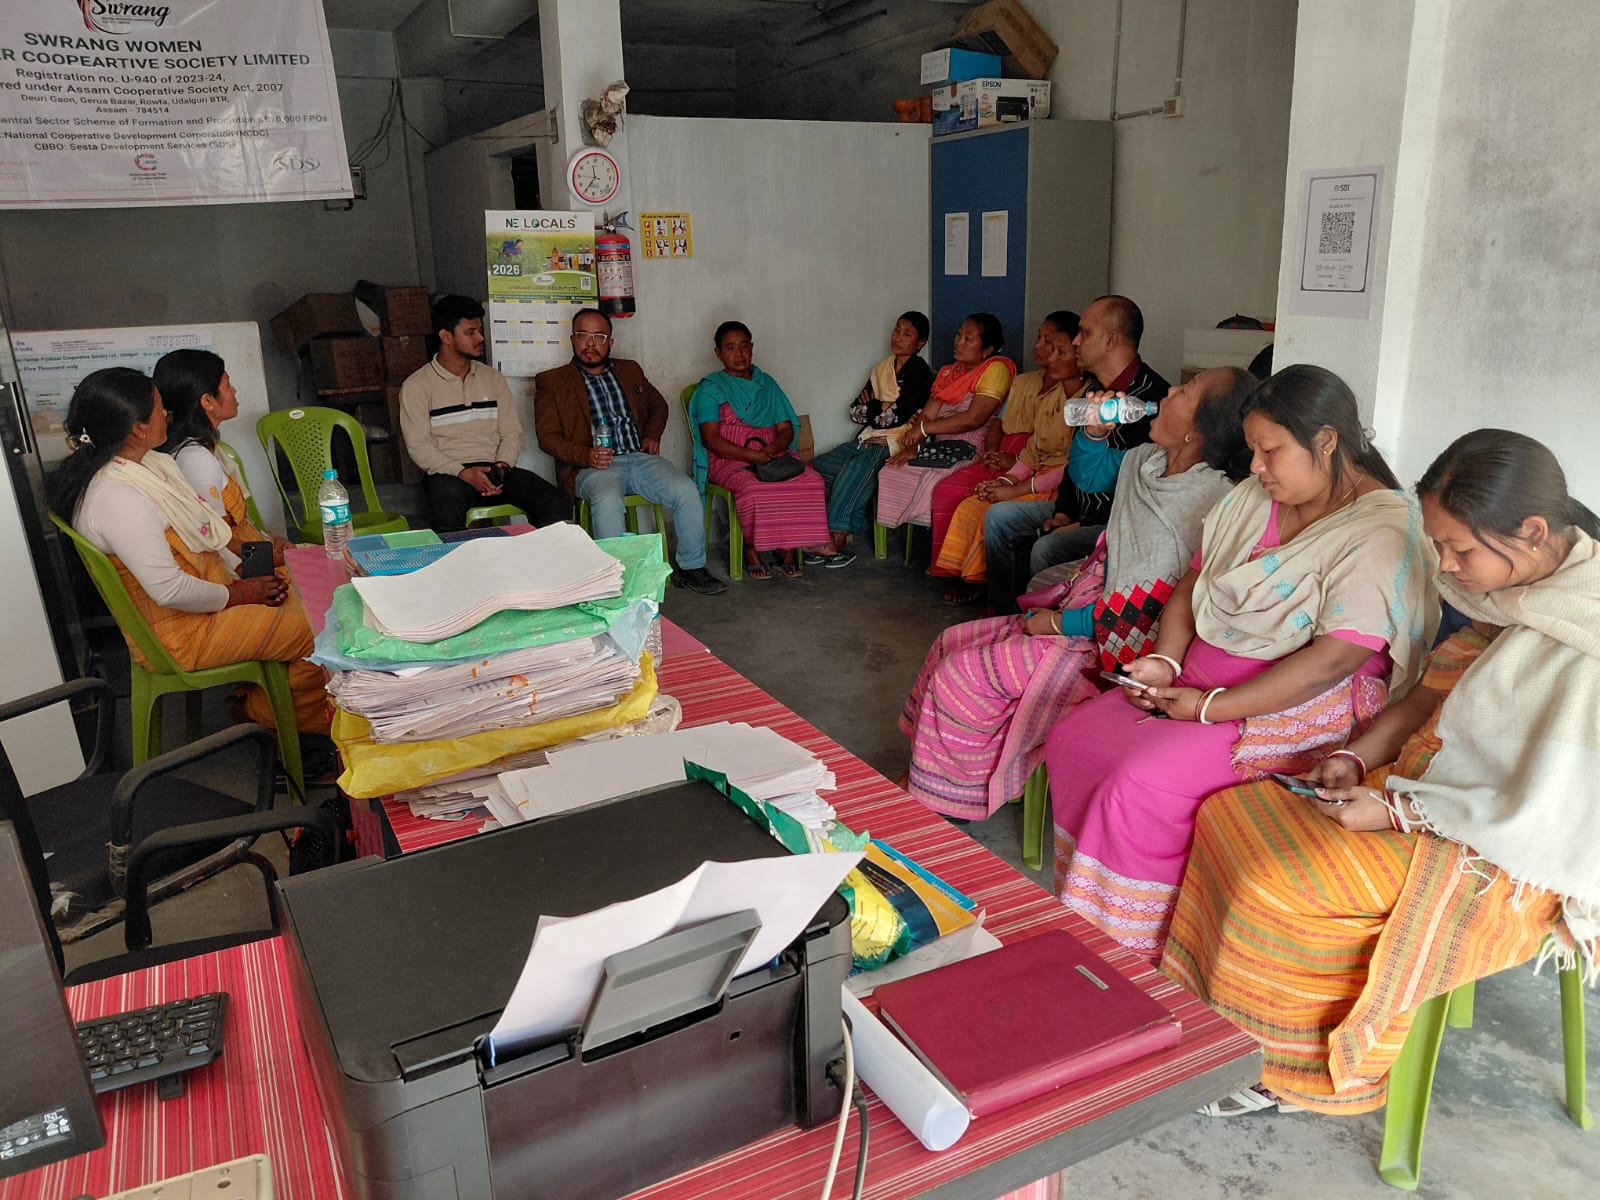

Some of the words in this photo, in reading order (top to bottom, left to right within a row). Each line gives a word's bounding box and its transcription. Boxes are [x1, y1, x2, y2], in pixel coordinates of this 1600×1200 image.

[92, 0, 170, 27] Swrang
[24, 32, 119, 52] SWRANG
[125, 40, 202, 53] WOMEN
[0, 48, 16, 61] R
[22, 51, 160, 69] COOPEARTIVE
[164, 55, 238, 69] SOCIETY
[243, 54, 310, 66] LIMITED
[16, 68, 95, 83] Registration
[99, 75, 118, 83] no.
[121, 75, 157, 84] U-940
[160, 74, 172, 83] of
[176, 73, 226, 83] 2023-24,
[25, 82, 64, 92] under
[67, 86, 110, 95] Assam
[113, 87, 185, 97] Cooperative
[187, 85, 229, 96] Society
[232, 83, 254, 93] Act,
[256, 83, 283, 92] 2007
[982, 80, 1002, 88] EPSON
[35, 117, 70, 125] Sector
[73, 118, 116, 126] Scheme
[119, 117, 130, 126] of
[132, 118, 183, 126] Formation
[186, 117, 204, 125] and
[303, 114, 328, 122] FPOs
[50, 132, 111, 141] Cooperative
[113, 132, 177, 141] Development
[179, 131, 234, 140] Corporation
[70, 143, 98, 151] Sesta
[100, 143, 165, 151] Development
[505, 218, 520, 228] NE
[523, 218, 576, 229] LOCALS
[492, 264, 520, 275] 2026
